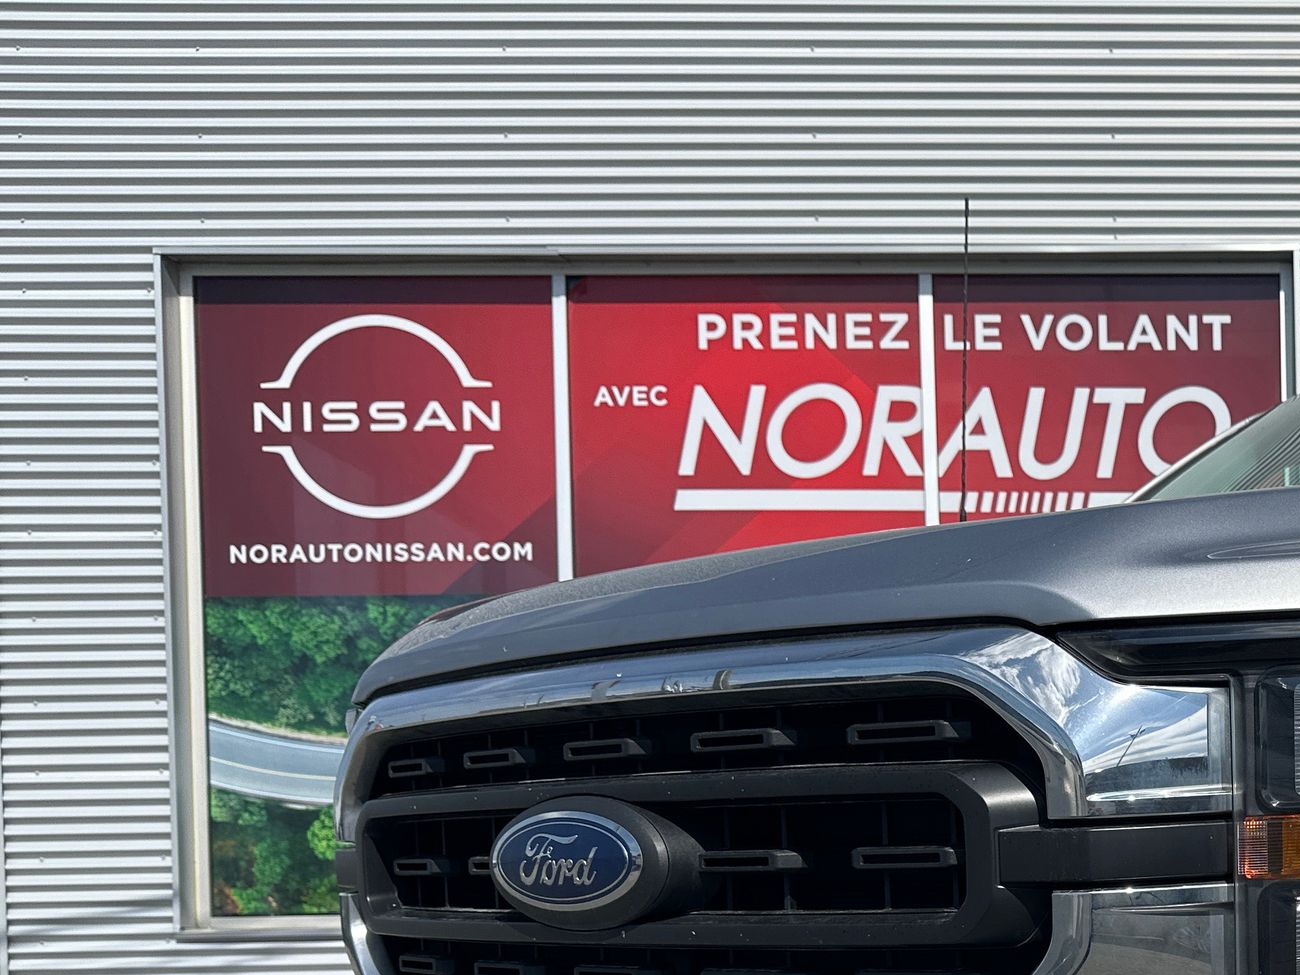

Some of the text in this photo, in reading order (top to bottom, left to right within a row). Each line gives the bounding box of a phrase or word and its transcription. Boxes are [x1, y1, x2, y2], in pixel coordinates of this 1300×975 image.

[697, 312, 1232, 351] PRENEZ LE VOLANT
[253, 400, 501, 433] NISSAN
[593, 383, 1232, 481] AVEC NORAUTO
[229, 541, 533, 564] NORAUTONISSAN.COM
[519, 833, 598, 886] Ford
